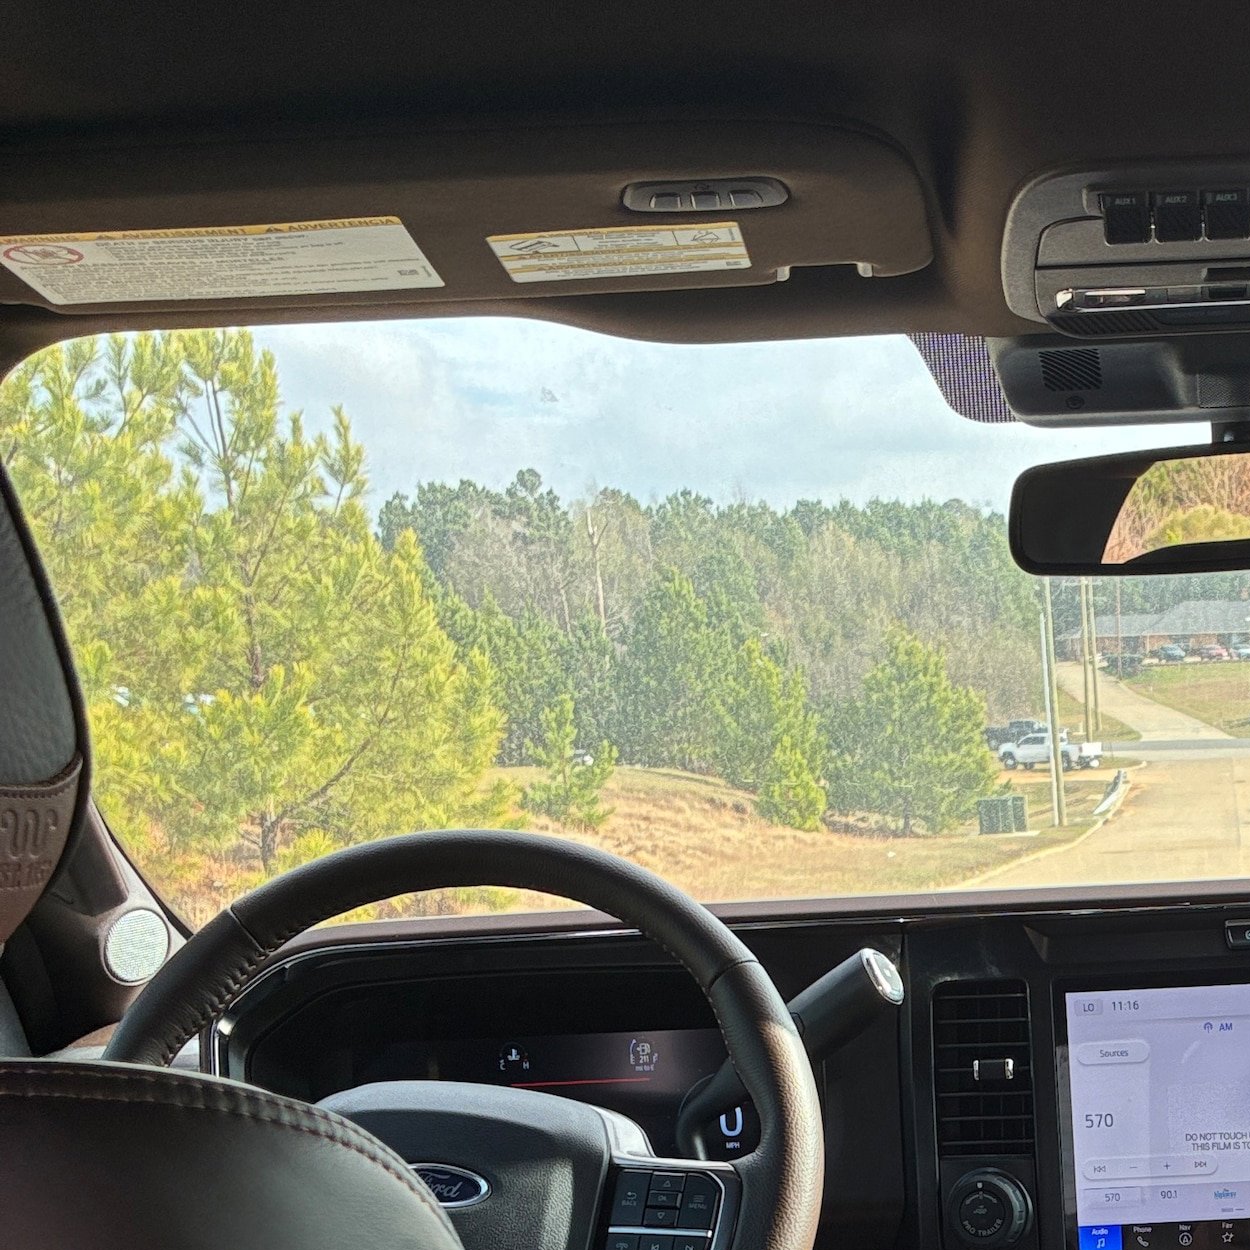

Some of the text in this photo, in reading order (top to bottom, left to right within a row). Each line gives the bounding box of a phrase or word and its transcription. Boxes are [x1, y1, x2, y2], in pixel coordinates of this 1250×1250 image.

[287, 218, 396, 231] ADVERTENCIA
[1083, 1003, 1094, 1012] LO
[1112, 1001, 1139, 1011] 11:16
[1219, 1023, 1233, 1031] AM
[1100, 1050, 1128, 1058] Sources
[1085, 1113, 1114, 1128] 570
[1186, 1133, 1198, 1141] DO
[1200, 1132, 1218, 1141] NOT
[1219, 1132, 1248, 1140] TOUCH
[1192, 1143, 1211, 1151] THIS
[1212, 1142, 1231, 1150] FILM
[1105, 1193, 1120, 1202] 570
[1160, 1190, 1177, 1200] 90.1
[963, 1218, 1002, 1237] PRO TRAILER
